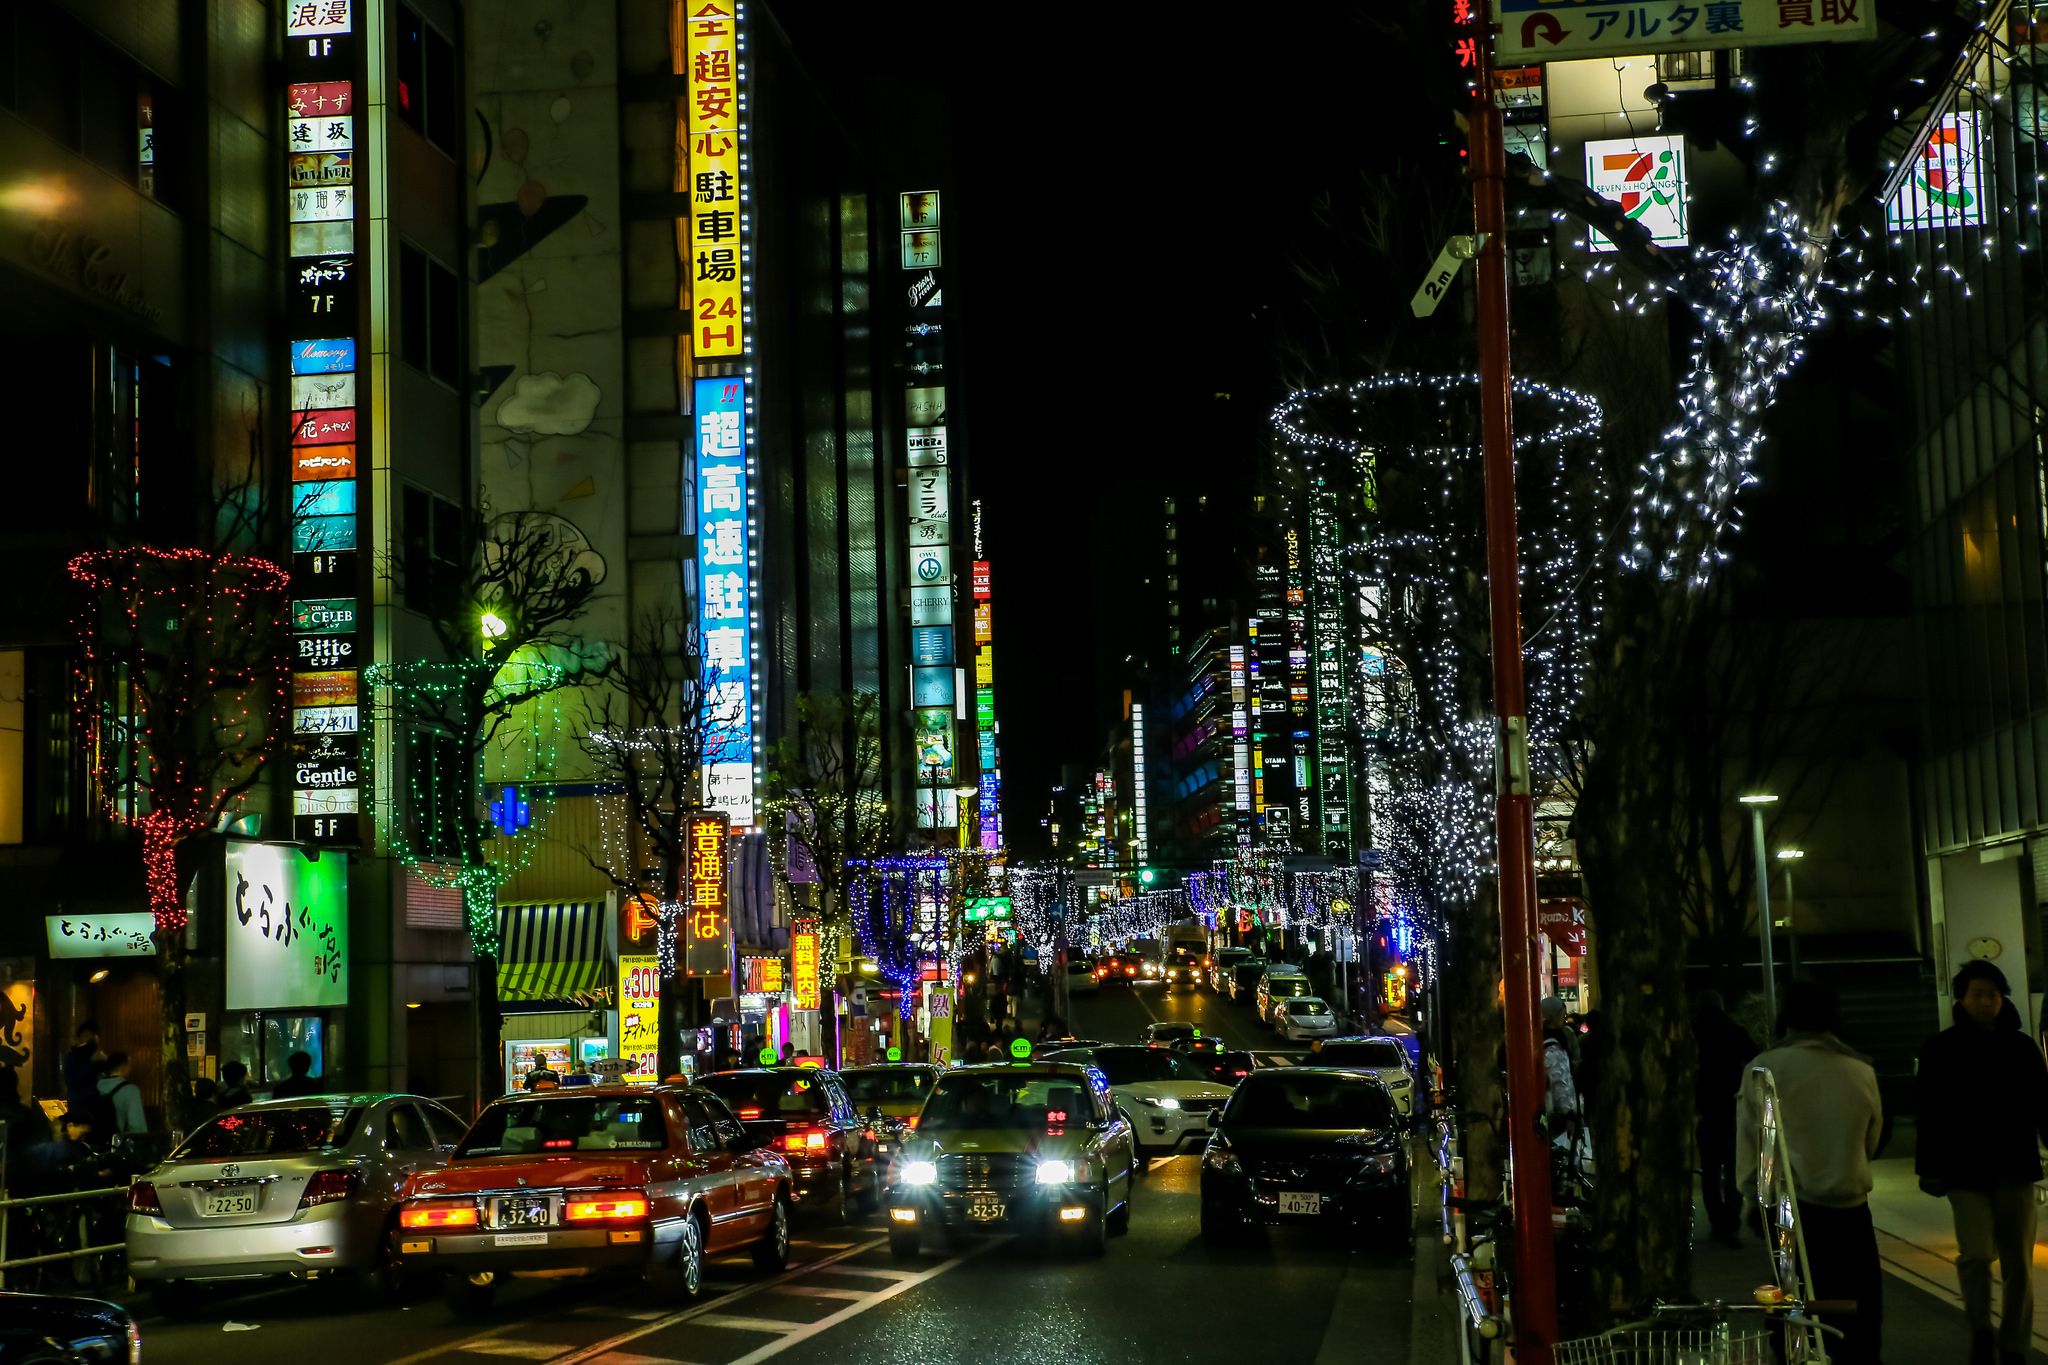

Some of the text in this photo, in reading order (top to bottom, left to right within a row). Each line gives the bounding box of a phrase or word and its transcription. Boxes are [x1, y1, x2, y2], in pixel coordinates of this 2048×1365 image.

[1586, 0, 1744, 41] アルタ裏
[291, 93, 348, 112] みすず
[292, 122, 349, 143] 逢坂
[291, 163, 351, 182] GULLIVER
[913, 252, 929, 263] 7F
[311, 295, 334, 312] 7F
[910, 401, 943, 412] PASHA
[936, 450, 945, 464] 5
[920, 478, 937, 514] マニラ
[930, 511, 947, 519] club
[913, 597, 949, 606] CHERRY
[311, 610, 353, 622] CELEB
[311, 657, 339, 666] ビッテ
[296, 766, 357, 785] Gentle
[1299, 797, 1309, 821] NOW
[314, 819, 338, 837] 5F
[692, 822, 724, 939] 普通車は
[796, 935, 816, 1009] 無料案内所
[761, 1052, 775, 1060] km
[1014, 1044, 1028, 1053] km
[216, 1198, 252, 1213] 22-50
[973, 1204, 1006, 1217] 52-57
[1287, 1201, 1318, 1213] 40-72
